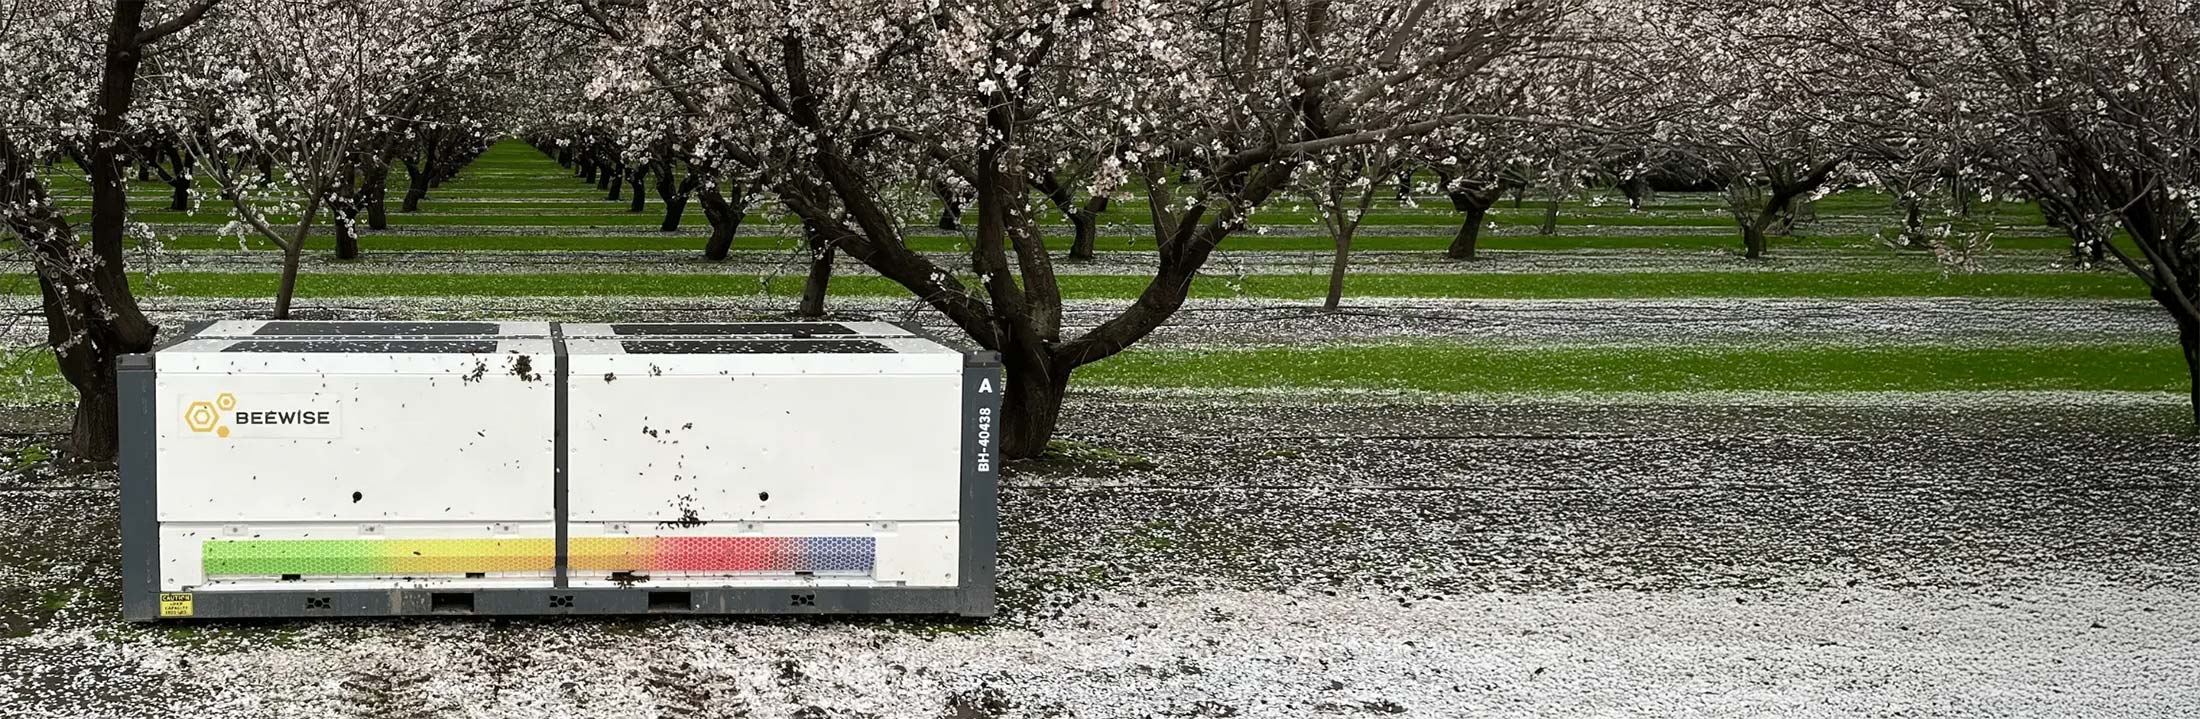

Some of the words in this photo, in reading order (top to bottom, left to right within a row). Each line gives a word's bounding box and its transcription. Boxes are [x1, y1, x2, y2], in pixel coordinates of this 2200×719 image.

[978, 378, 993, 393] A
[236, 410, 330, 425] BEEWISE
[977, 407, 991, 472] BH-40438
